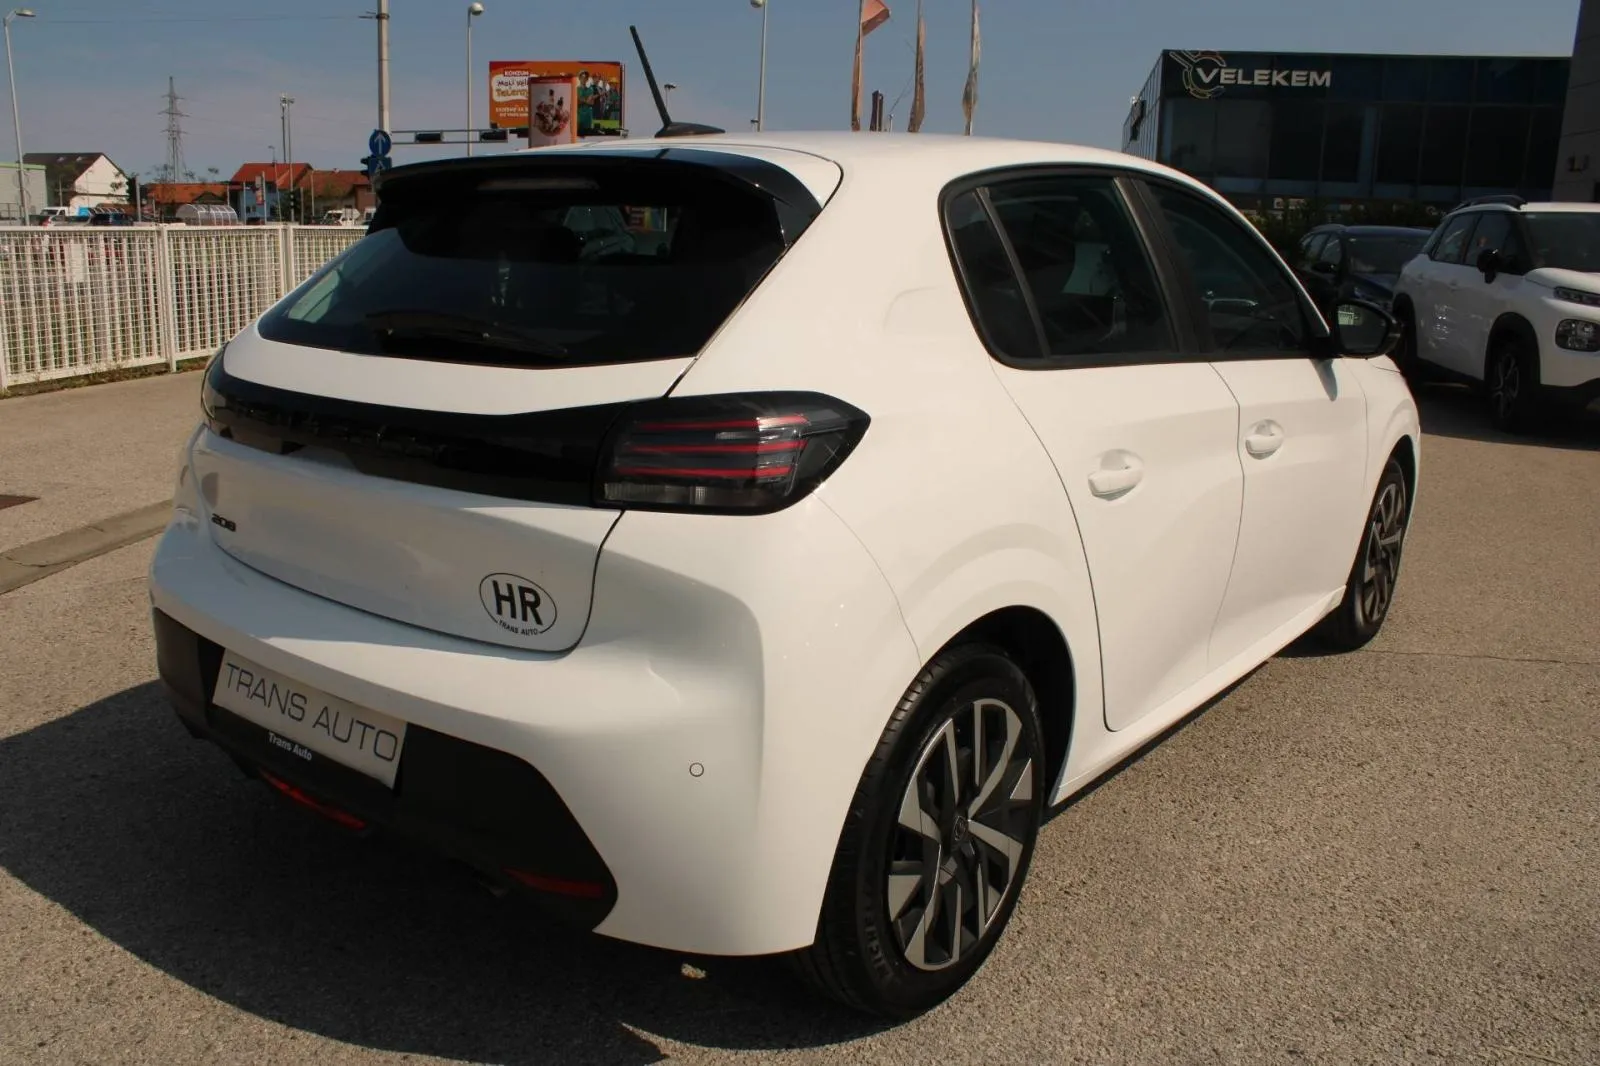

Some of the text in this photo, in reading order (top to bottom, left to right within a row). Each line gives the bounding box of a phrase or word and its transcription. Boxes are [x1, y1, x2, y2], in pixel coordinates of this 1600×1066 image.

[1195, 67, 1332, 87] VELEKEM
[492, 580, 543, 626] HR
[499, 619, 538, 636] TRANS AUTO
[226, 662, 398, 762] TRANS AUTO
[268, 731, 313, 761] Trans Auto
